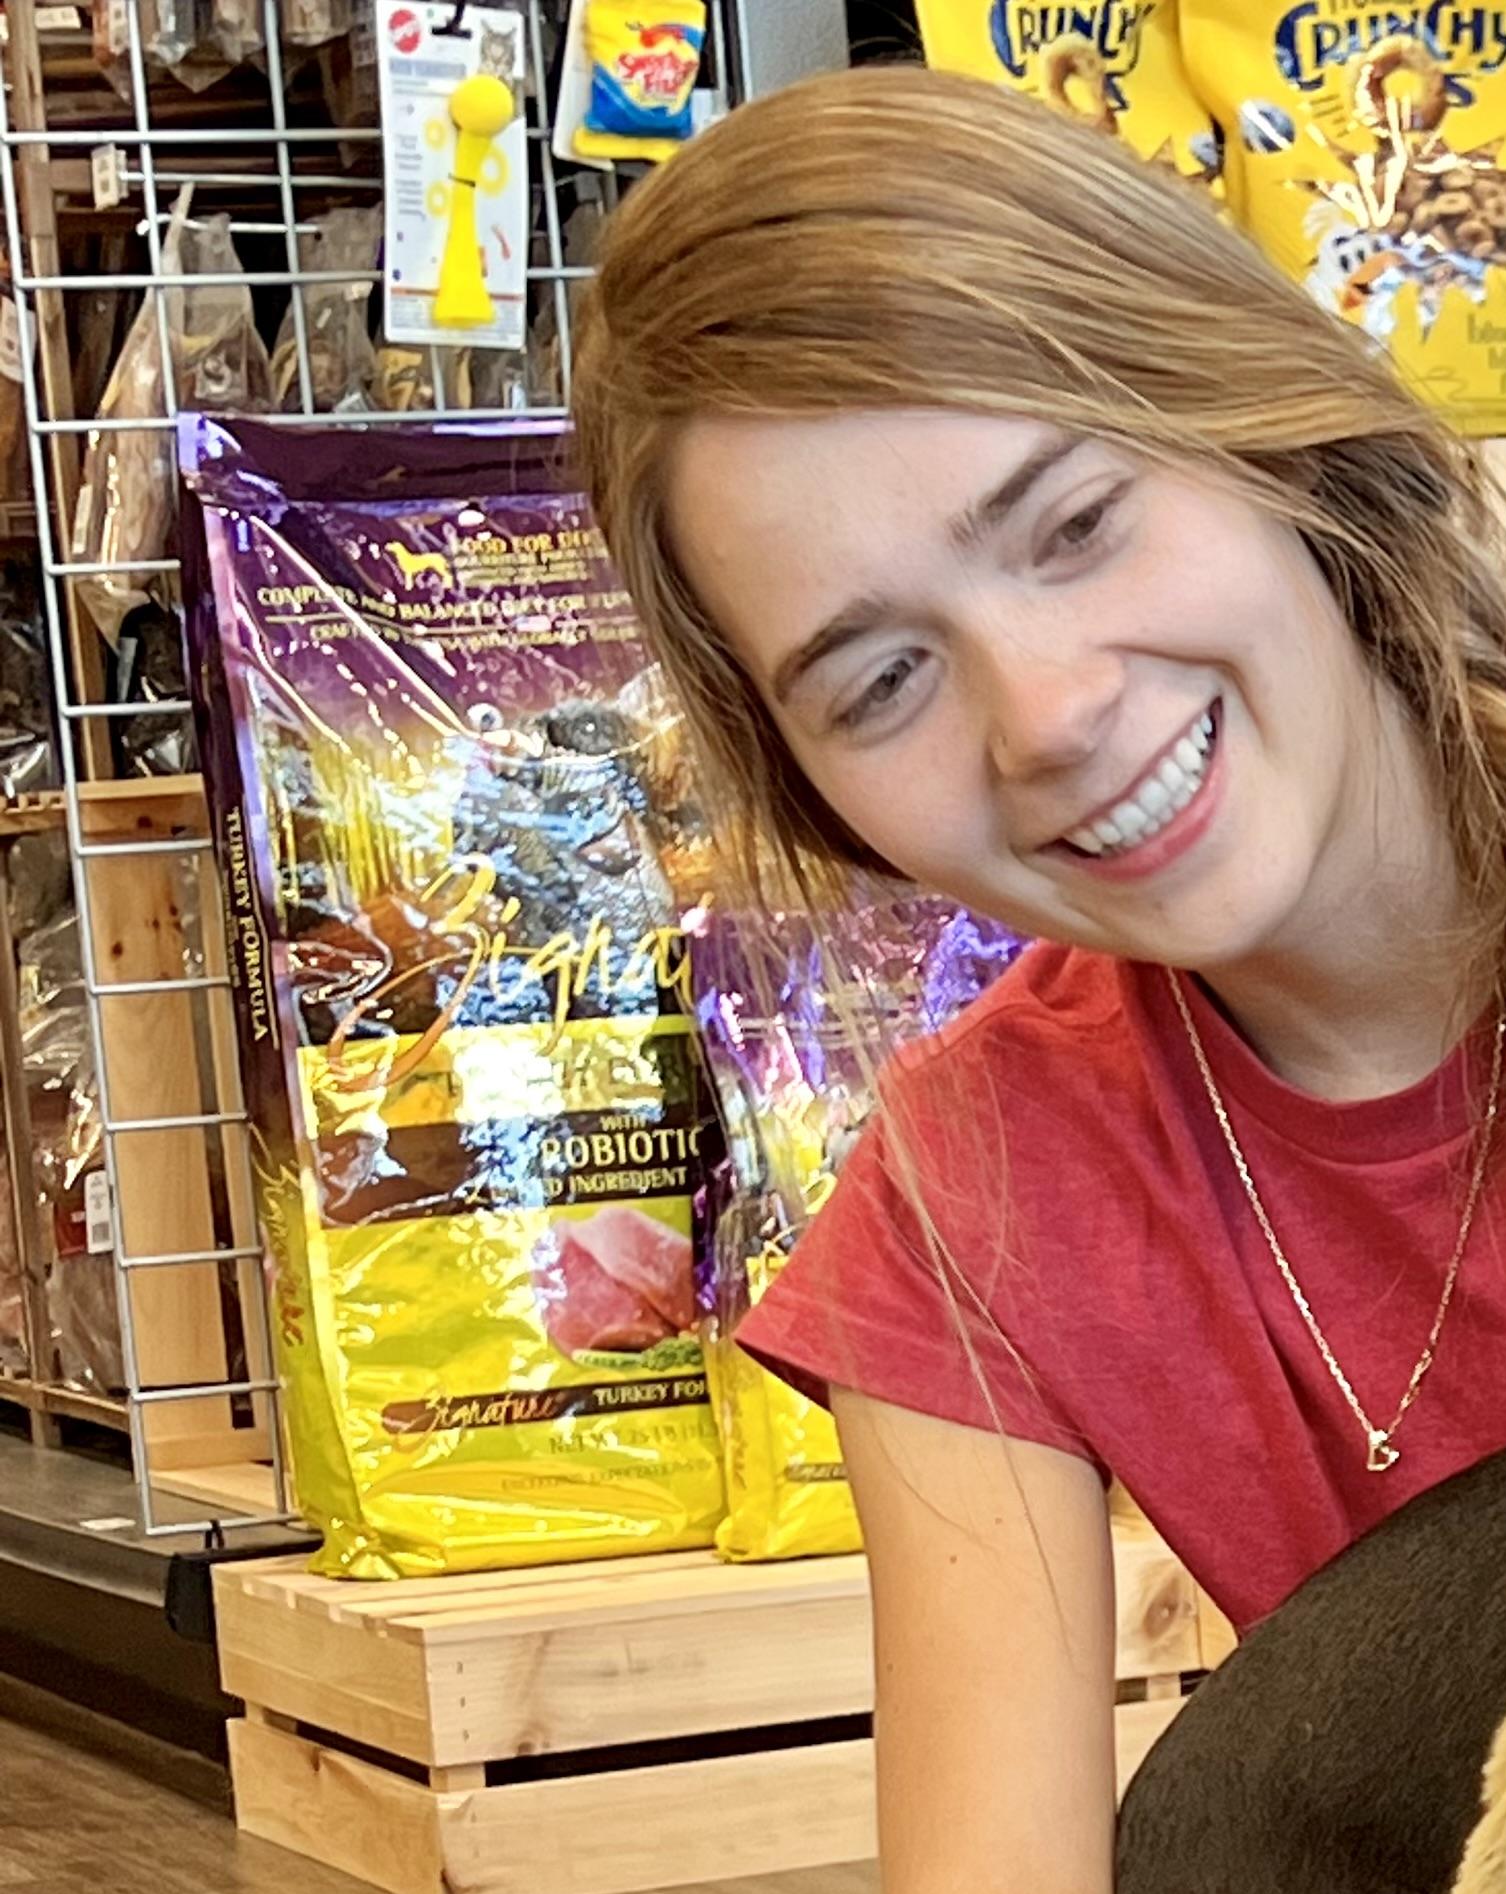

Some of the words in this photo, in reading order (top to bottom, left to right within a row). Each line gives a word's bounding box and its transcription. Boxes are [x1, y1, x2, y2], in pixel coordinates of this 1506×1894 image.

[511, 533, 554, 552] FOR
[257, 584, 359, 607] COMPLTE
[226, 805, 253, 910] TURKEY
[239, 914, 269, 1042] FORMULA
[599, 1111, 646, 1132] WITH
[537, 1127, 702, 1170] ROBIOTIC
[569, 1166, 689, 1197] INGREDIENT
[594, 1384, 667, 1406] TURKEY
